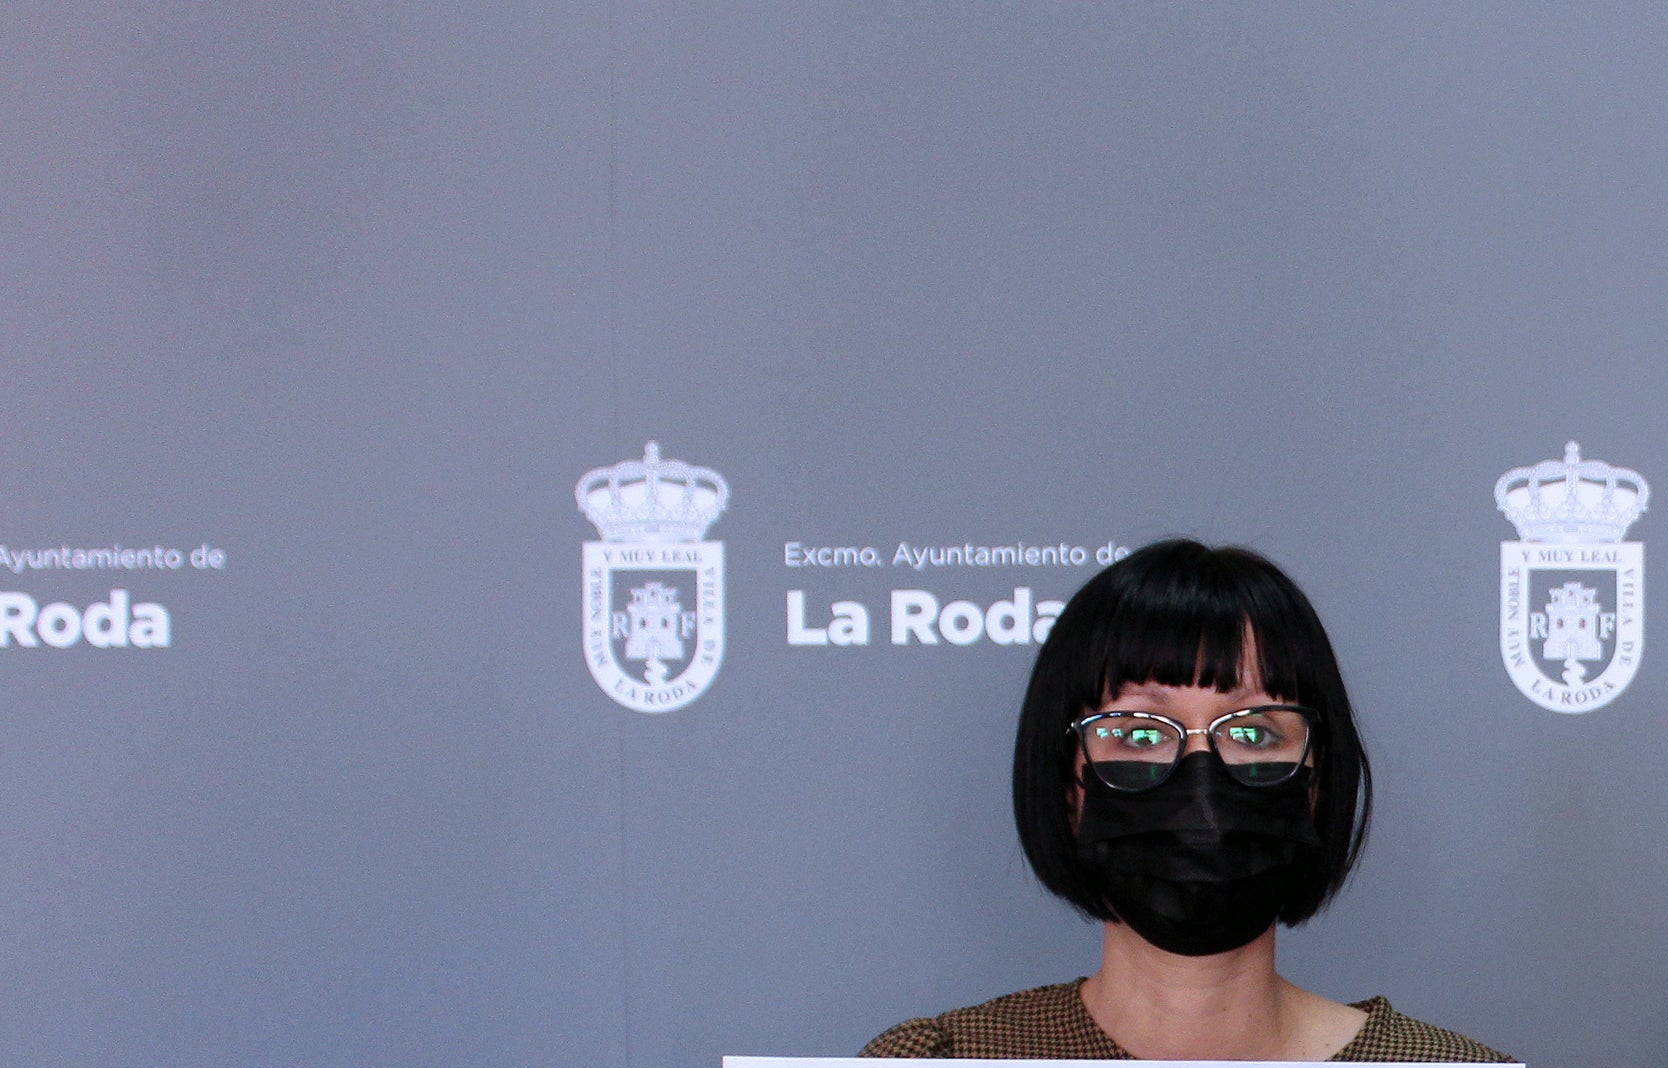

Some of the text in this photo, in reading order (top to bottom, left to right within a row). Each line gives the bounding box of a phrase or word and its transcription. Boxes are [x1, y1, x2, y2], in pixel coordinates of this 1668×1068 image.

[190, 543, 225, 569] de
[784, 541, 1131, 571] Excmo. Ayuntamiento de
[1538, 551, 1574, 562] MUY
[1581, 551, 1622, 562] LEAL
[786, 590, 870, 646] La
[1531, 679, 1616, 704] LA RODA
